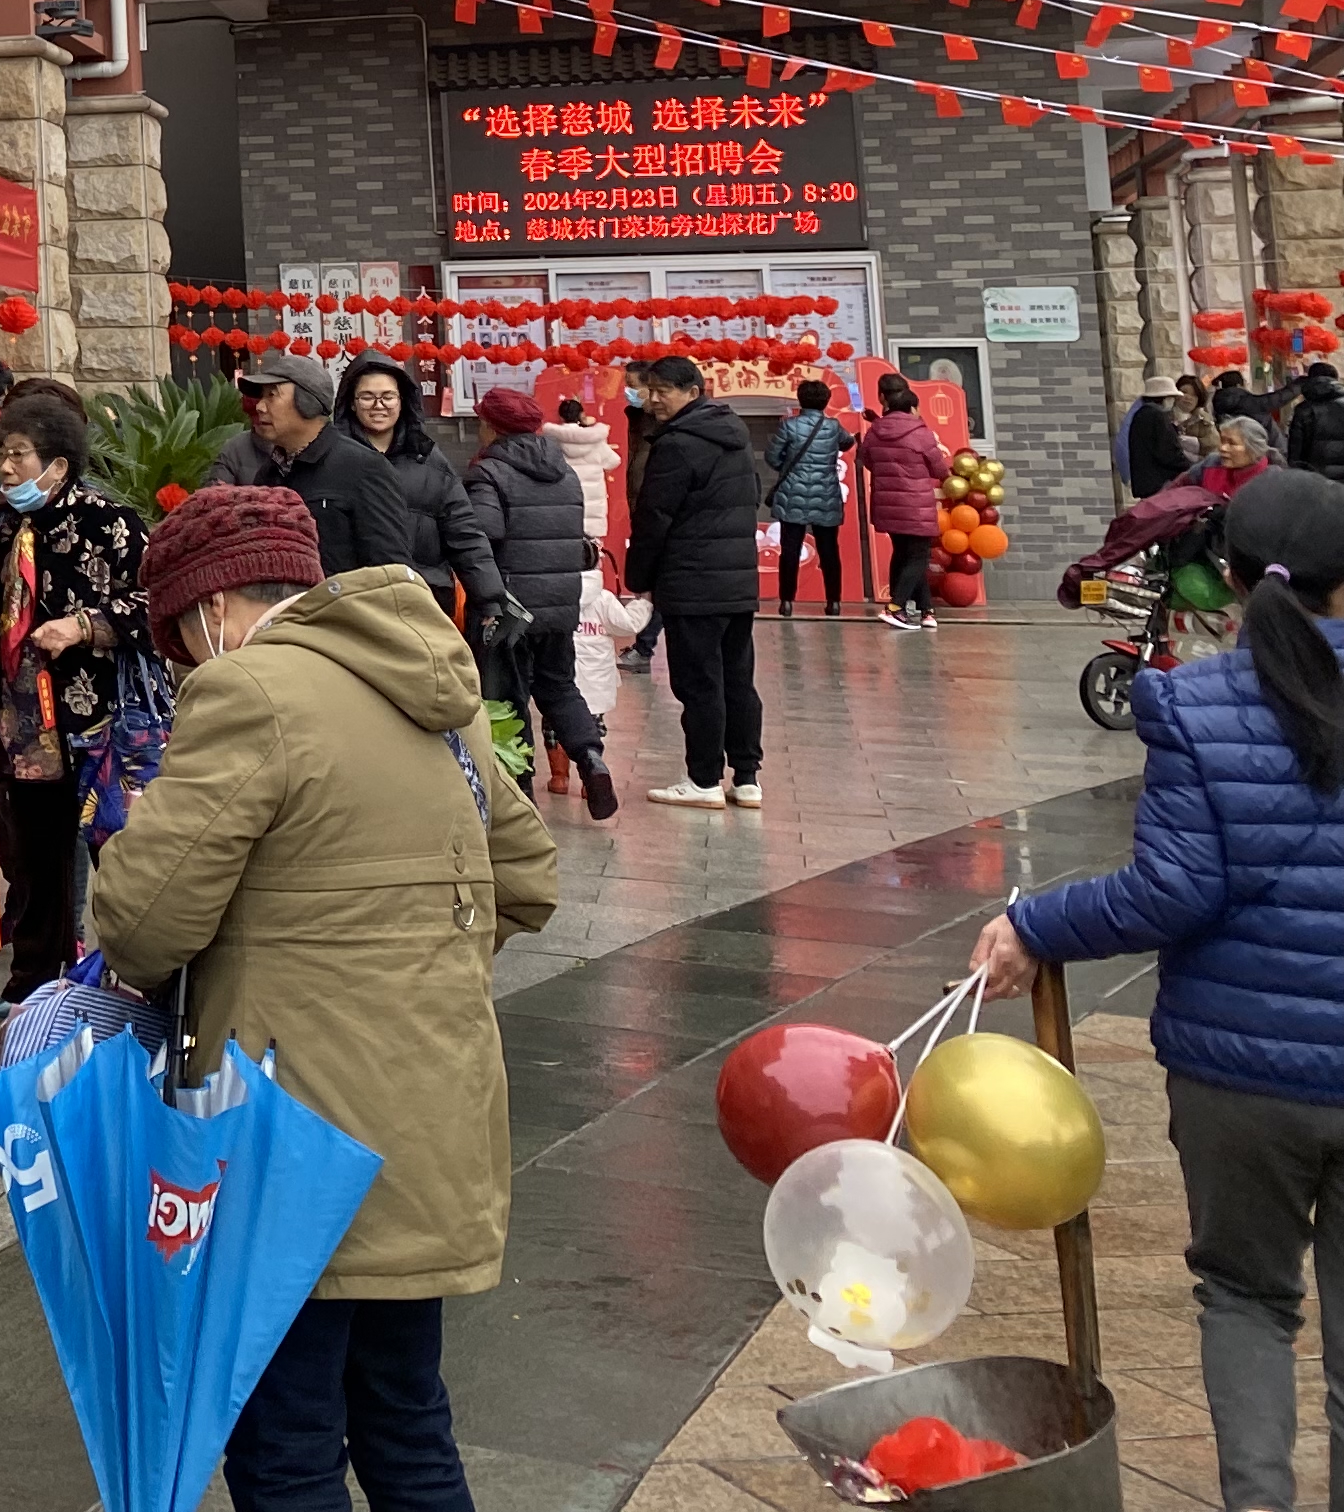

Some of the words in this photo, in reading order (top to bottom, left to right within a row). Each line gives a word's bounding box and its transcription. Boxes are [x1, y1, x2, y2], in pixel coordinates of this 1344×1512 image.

[520, 137, 785, 183] 春季大型招聘会
